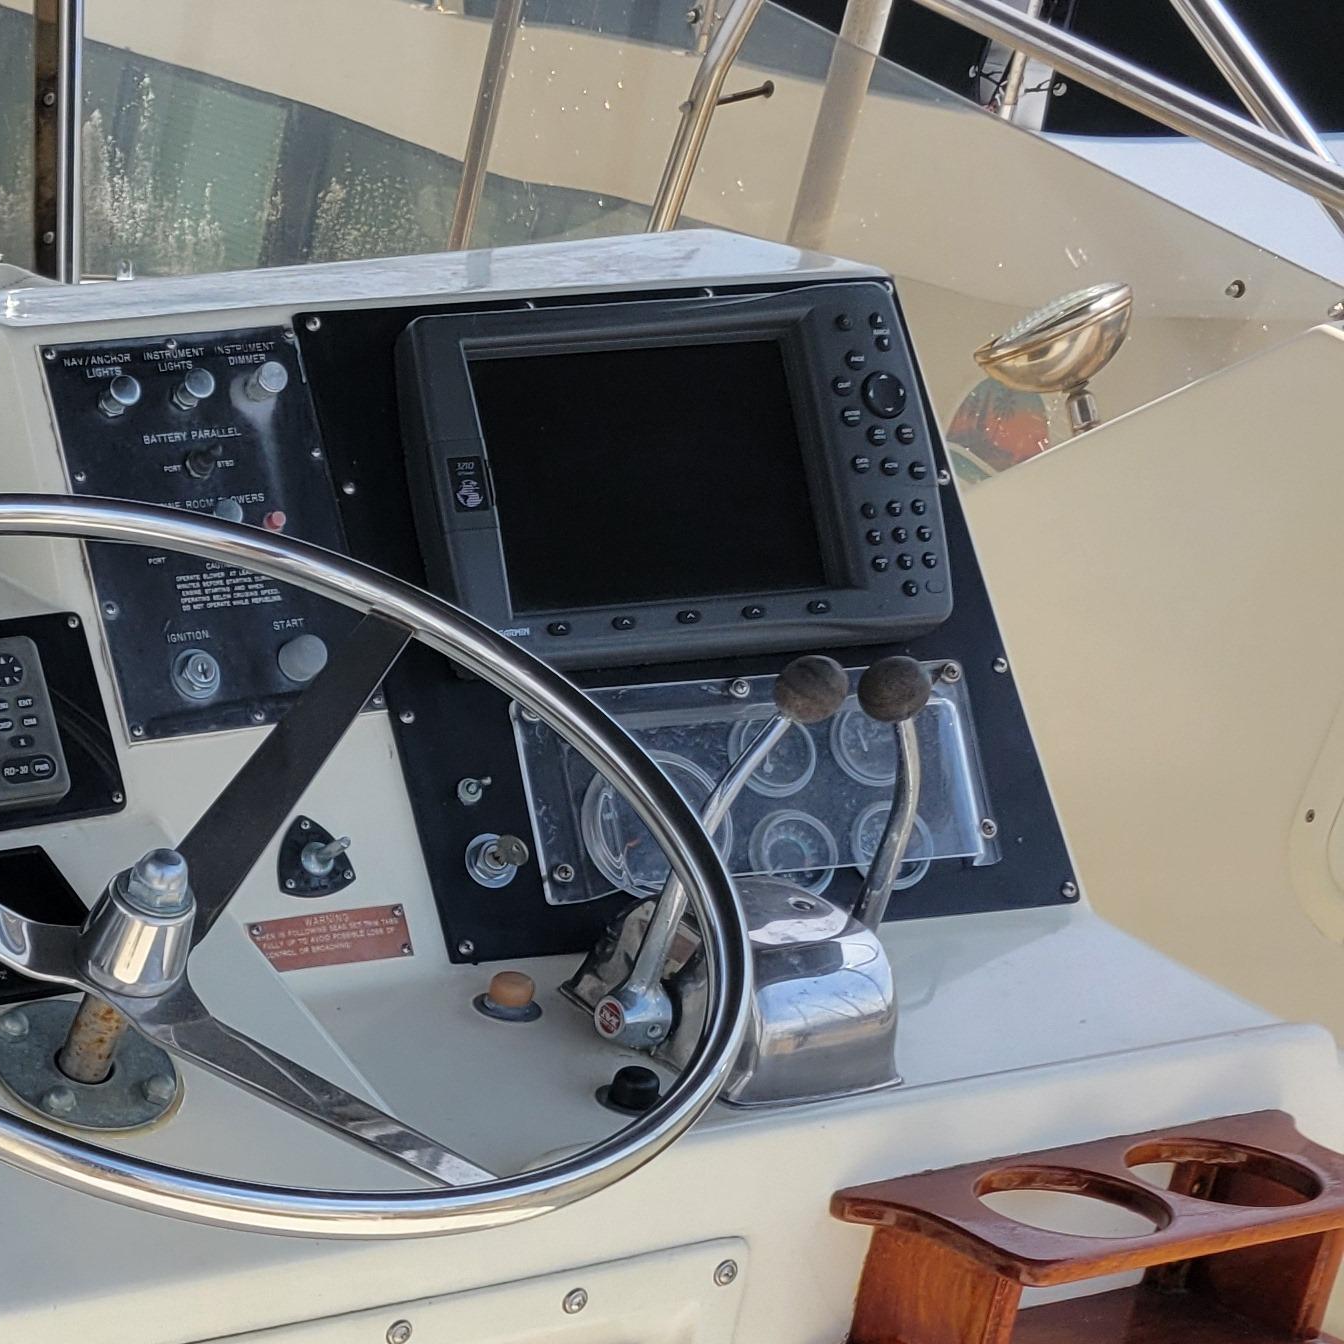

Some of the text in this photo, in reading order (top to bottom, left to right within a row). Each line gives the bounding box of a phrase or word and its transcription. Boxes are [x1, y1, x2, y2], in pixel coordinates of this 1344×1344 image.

[143, 348, 205, 360] INSTRUMENT
[214, 342, 275, 354] INSTRUMENT
[63, 354, 131, 367] NAV/ANCHOR
[228, 354, 266, 366] DIMMER
[86, 367, 123, 378] LIGHTS
[158, 361, 193, 372] LIGHTS
[143, 428, 242, 444] BATTERY PARALLEL
[148, 557, 167, 565] PORT
[272, 618, 305, 631] START
[167, 630, 210, 643] IGNITION
[4, 765, 29, 776] RD-30
[305, 913, 350, 926] WARNING
